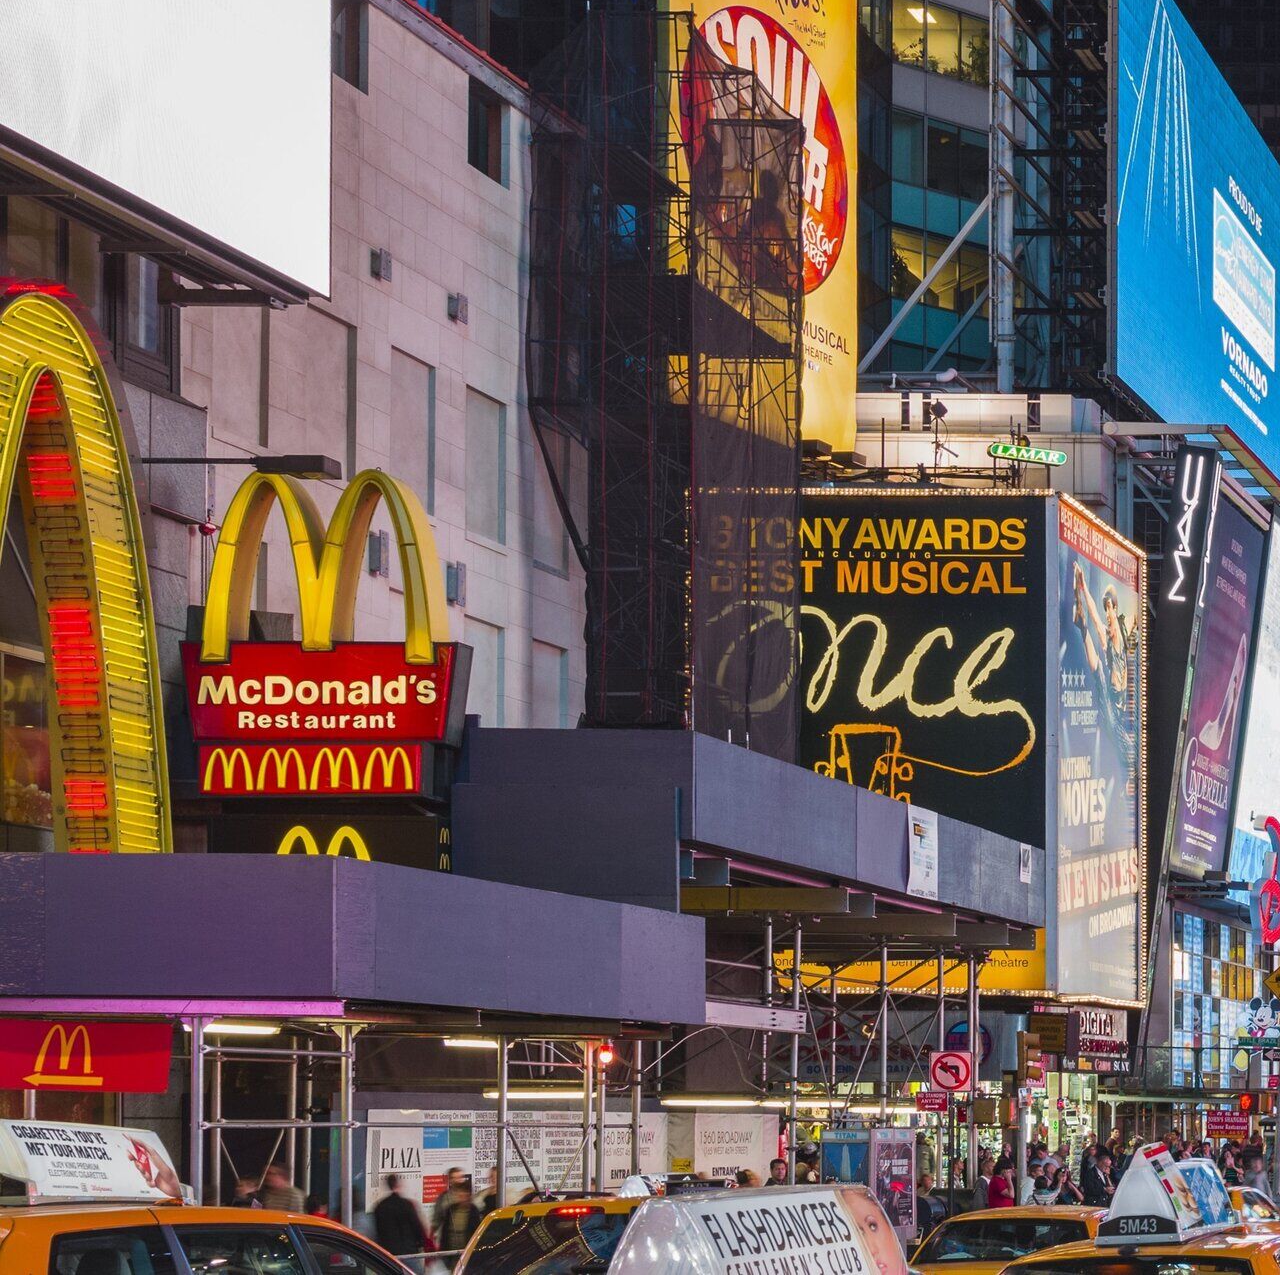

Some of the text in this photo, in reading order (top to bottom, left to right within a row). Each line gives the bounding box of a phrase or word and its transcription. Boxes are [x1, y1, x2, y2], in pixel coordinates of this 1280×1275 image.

[1221, 326, 1268, 398] VORNADO
[997, 445, 1059, 462] LAMAR
[853, 518, 1027, 551] AWARDS
[837, 561, 1027, 594] MUSICAL
[197, 675, 437, 705] McDonald's
[238, 711, 396, 729] Restaurant
[1060, 776, 1107, 828] MOVES
[1059, 847, 1138, 913] NEWSIES
[990, 958, 1029, 968] theatre
[1080, 1012, 1118, 1036] DIGITAL
[424, 1112, 452, 1121] What's Going
[70, 1129, 107, 1145] YOU'VE
[700, 1132, 753, 1144] 1560 BROADWAY
[24, 1141, 112, 1161] MET YOUR MATCH.
[381, 1147, 421, 1169] PLAZA
[701, 1201, 851, 1259] FLASHDANCERS
[1119, 1218, 1157, 1234] 5M43
[827, 1247, 862, 1273] CLUB
